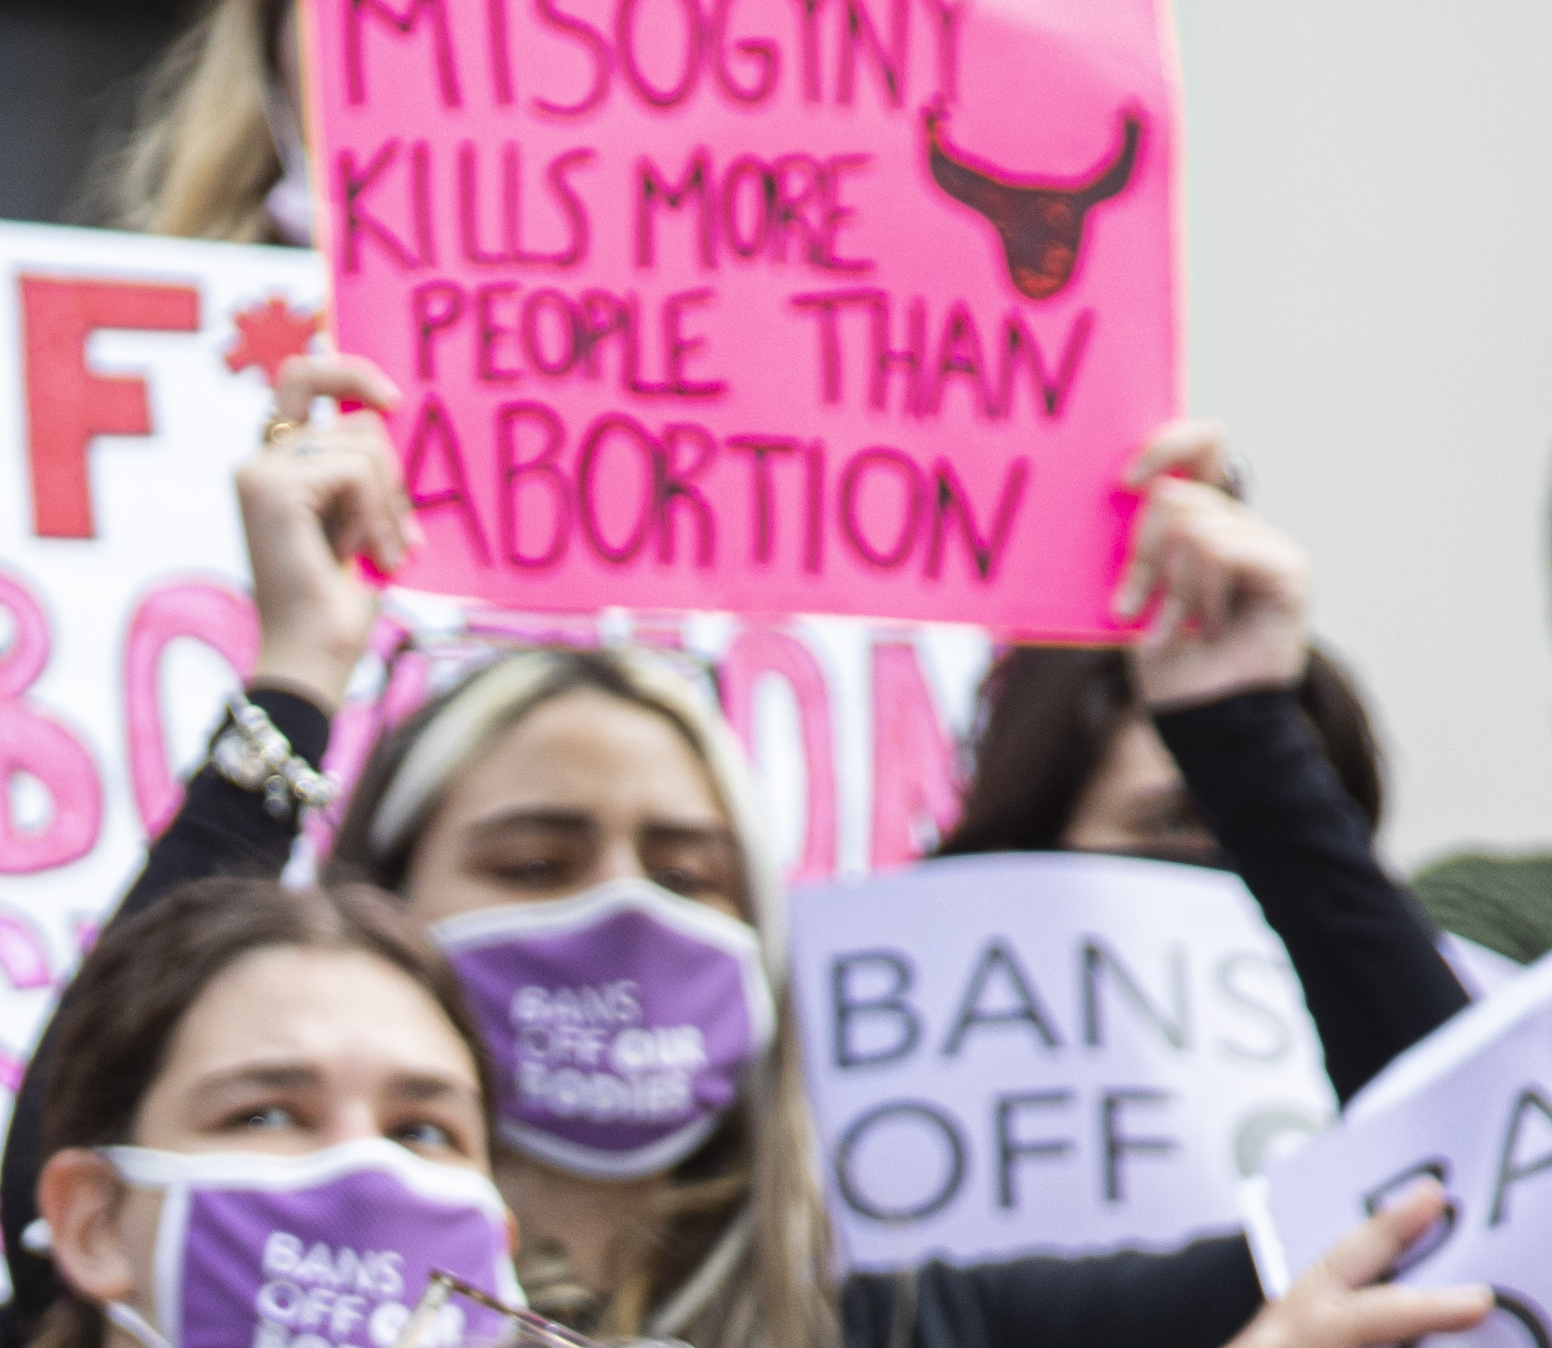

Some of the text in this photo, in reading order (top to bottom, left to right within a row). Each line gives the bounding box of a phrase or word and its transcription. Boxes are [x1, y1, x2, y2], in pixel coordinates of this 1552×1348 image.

[336, 138, 876, 276] KILLS MORE
[410, 279, 1101, 423] PEOPLE THAN
[404, 392, 1032, 582] ABORTION
[830, 937, 1296, 1068] BANS
[832, 1090, 1180, 1226] OFF
[255, 1278, 367, 1334] OFF
[262, 1229, 405, 1298] BANS
